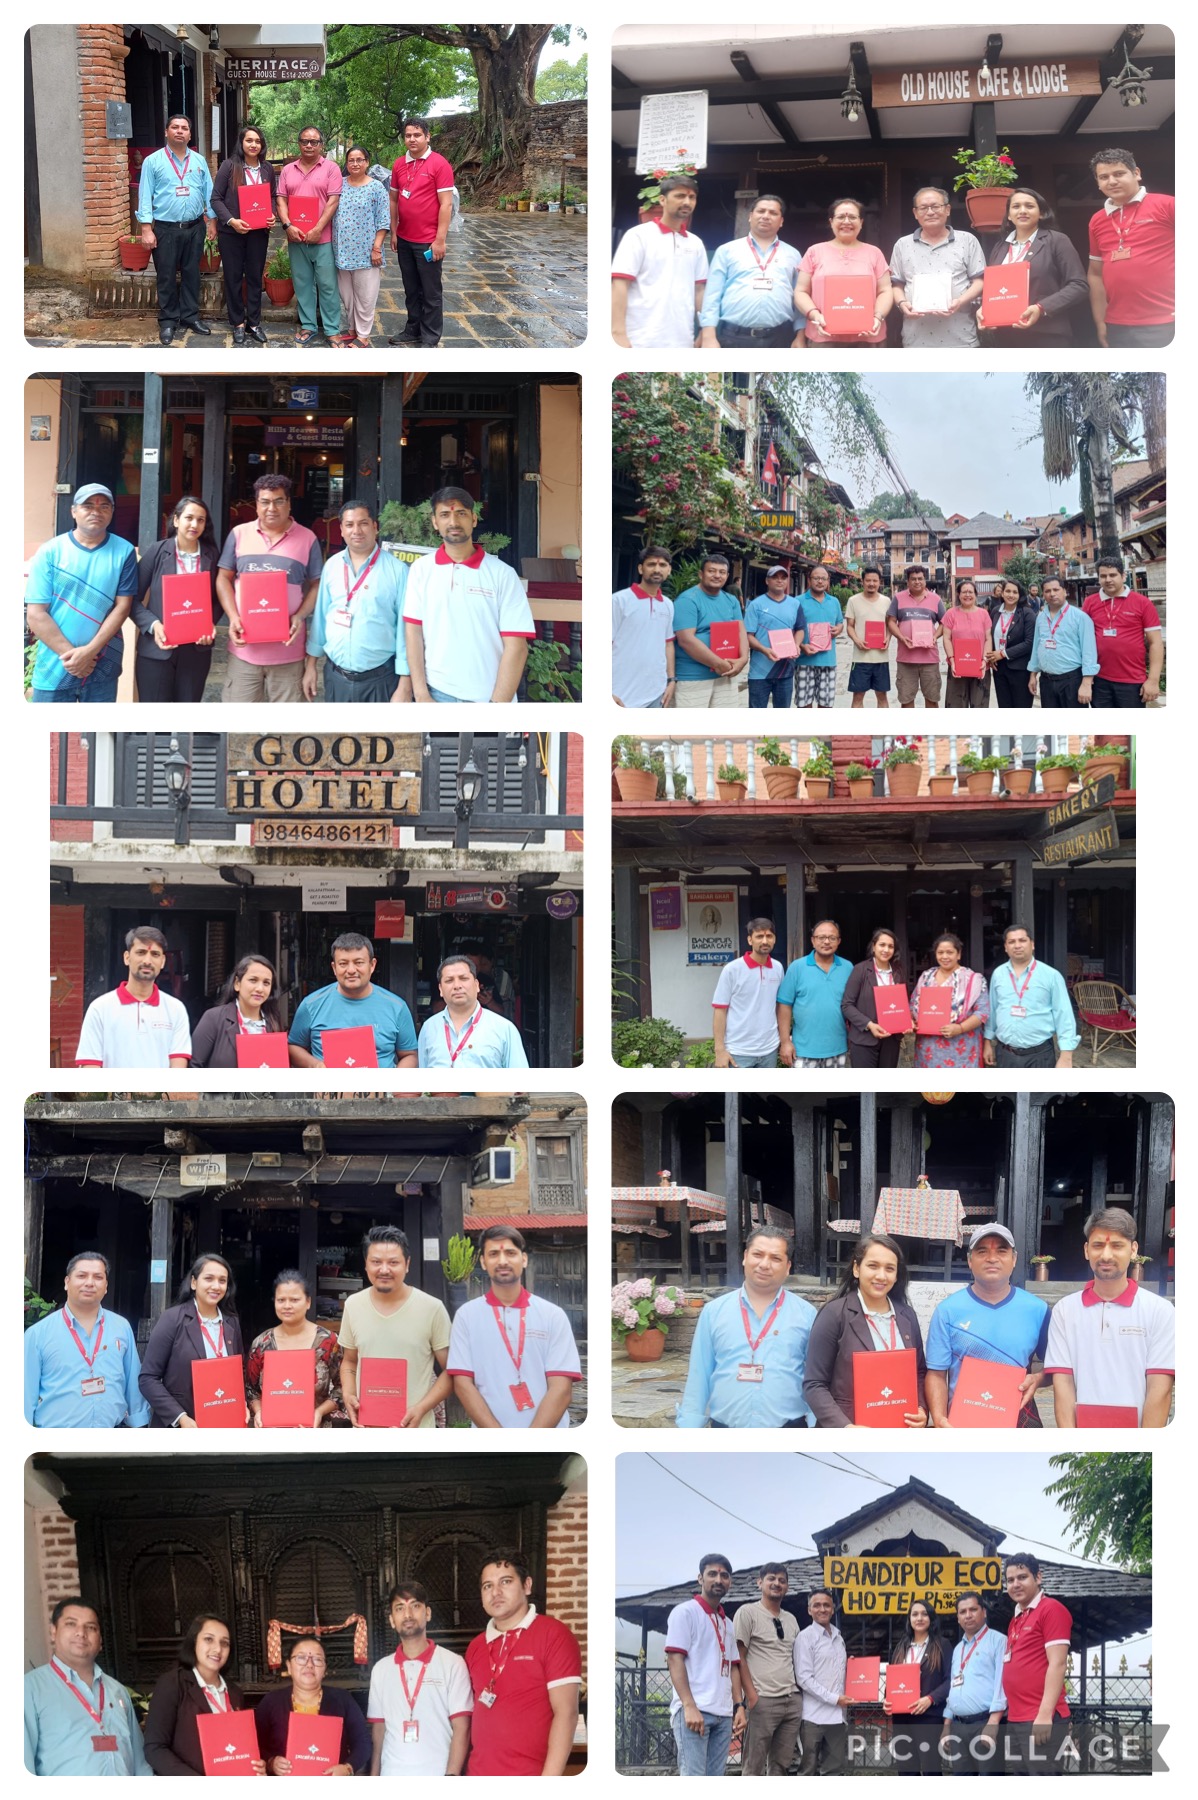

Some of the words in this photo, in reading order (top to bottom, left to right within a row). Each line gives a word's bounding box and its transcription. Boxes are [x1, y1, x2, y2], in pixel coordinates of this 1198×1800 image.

[228, 60, 308, 70] HERITAGE
[255, 70, 277, 78] HOUSE
[902, 73, 924, 102] OLD
[928, 70, 970, 100] HOUSE
[977, 68, 1010, 97] CAFE
[1012, 67, 1023, 96] &
[1024, 64, 1068, 94] LODGE
[760, 514, 777, 527] OLD
[779, 514, 794, 527] INN
[254, 736, 394, 766] GOOD
[233, 778, 408, 809] HOTEL
[1049, 784, 1099, 826] BAKERY
[263, 824, 387, 842] 9846486121
[1044, 825, 1112, 864] RESTAURANT
[694, 953, 730, 962] Bakery
[830, 1560, 944, 1587] BANDIPUR
[955, 1561, 1000, 1587] ECO
